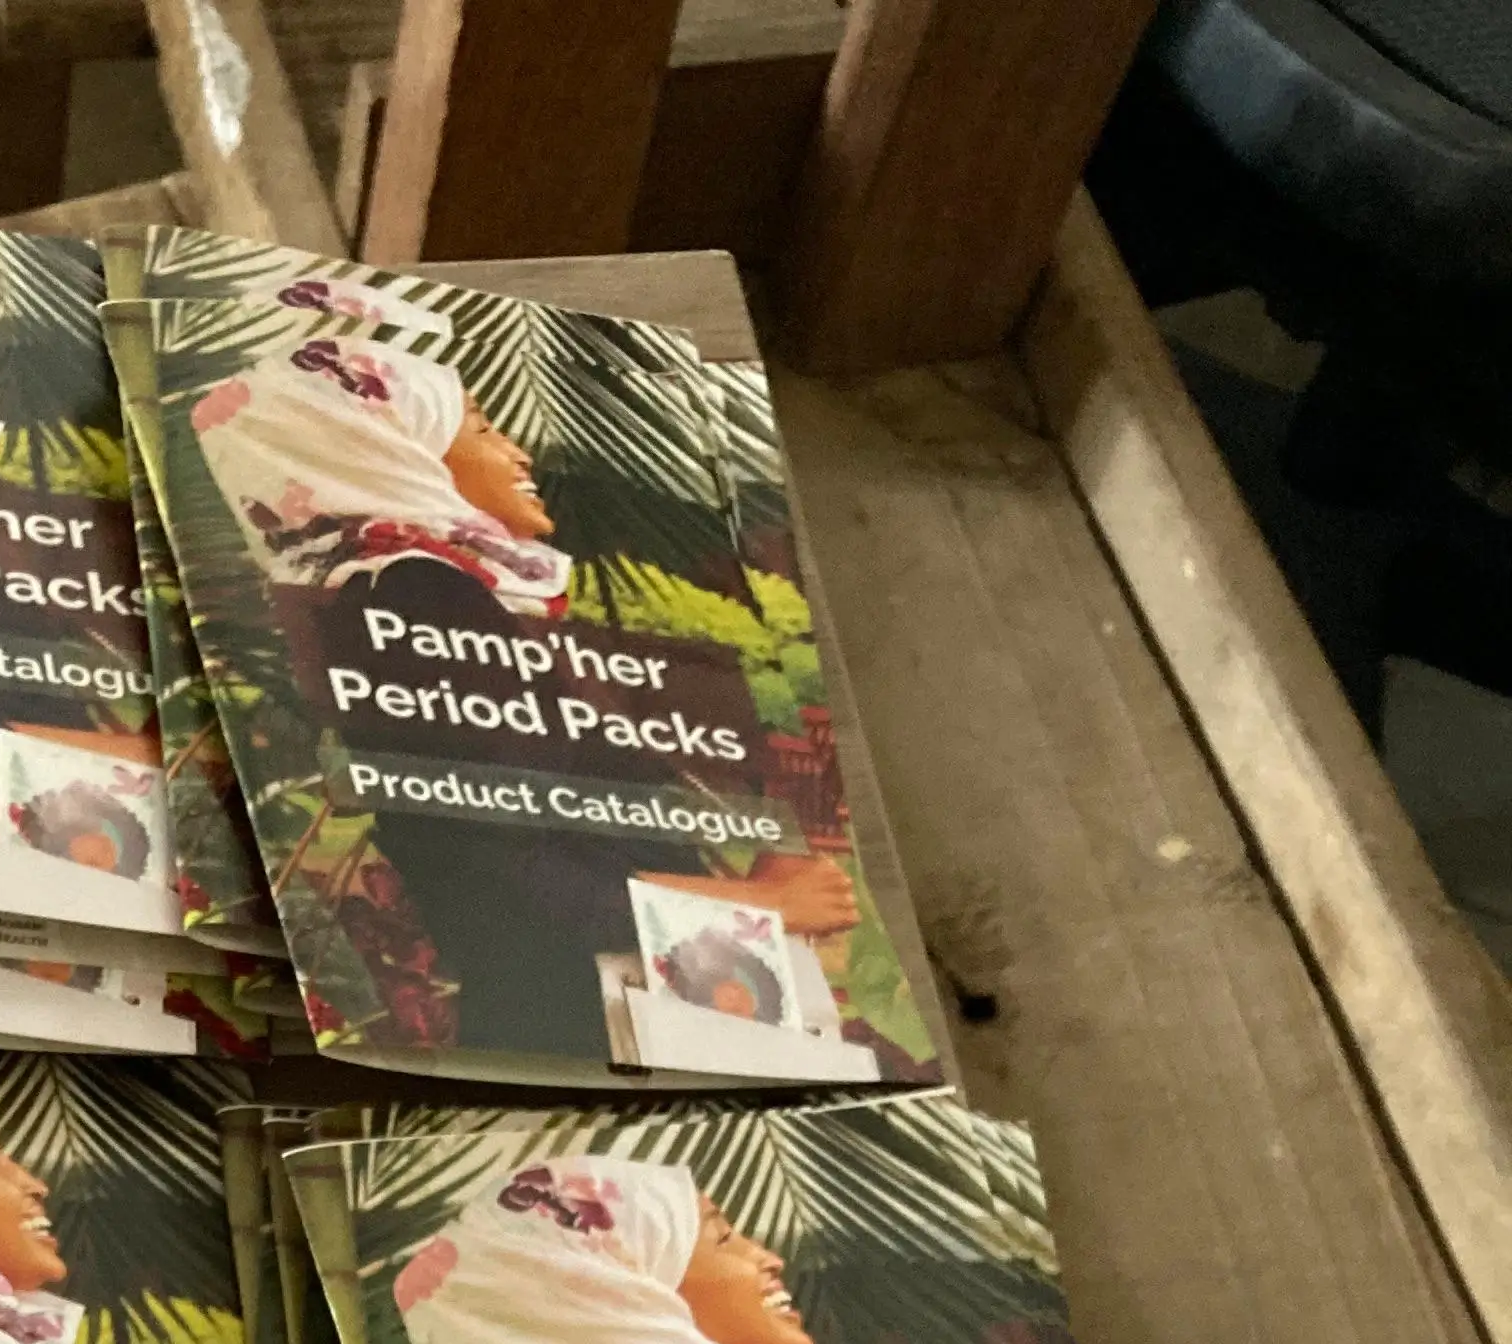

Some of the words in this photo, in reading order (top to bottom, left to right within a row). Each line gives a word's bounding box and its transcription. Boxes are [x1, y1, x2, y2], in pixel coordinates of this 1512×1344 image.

[362, 608, 669, 689] Pamp'her
[327, 668, 547, 736] Period
[558, 697, 746, 762] Packs
[348, 763, 540, 815] Product
[548, 787, 782, 843] Catalogue
